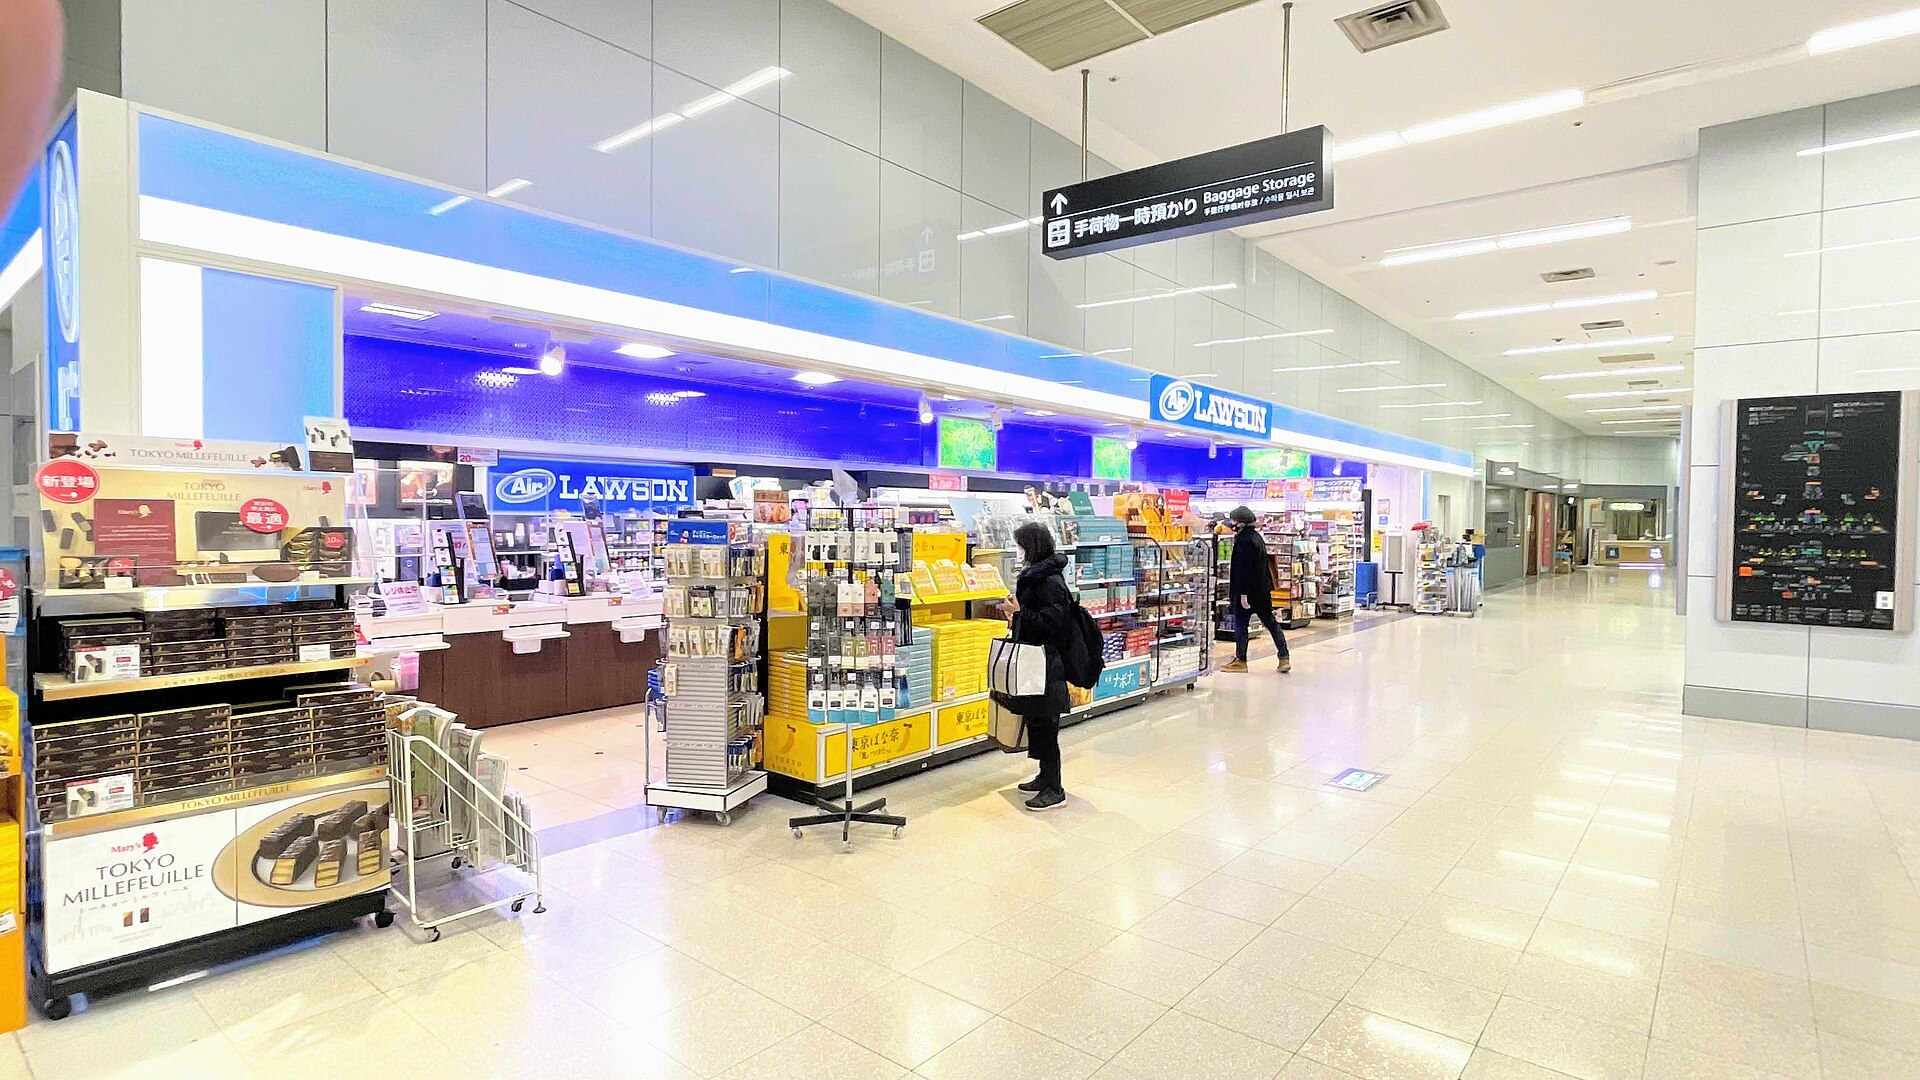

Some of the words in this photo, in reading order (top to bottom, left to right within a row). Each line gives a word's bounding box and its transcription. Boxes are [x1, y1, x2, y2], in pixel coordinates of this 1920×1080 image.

[1203, 184, 1260, 204] Baggage
[1262, 172, 1316, 192] Storage
[1073, 198, 1198, 238] 手荷物一時預かり
[1193, 390, 1267, 434] LAWSON
[129, 448, 174, 459] TOKYO
[175, 450, 248, 462] MILLEFEUILLE
[42, 475, 95, 489] 新登場
[184, 482, 226, 492] TOKYO
[511, 478, 543, 495] Air
[559, 475, 689, 502] LAWSON
[166, 491, 241, 501] MILLEFEUILLE
[246, 512, 283, 525] 最適
[181, 796, 222, 810] TOKYO
[223, 784, 291, 802] MILLEFEUILLE
[110, 842, 142, 854] Mary's
[96, 853, 175, 880] TOKYO
[62, 864, 204, 907] MILLEFEUILLE
